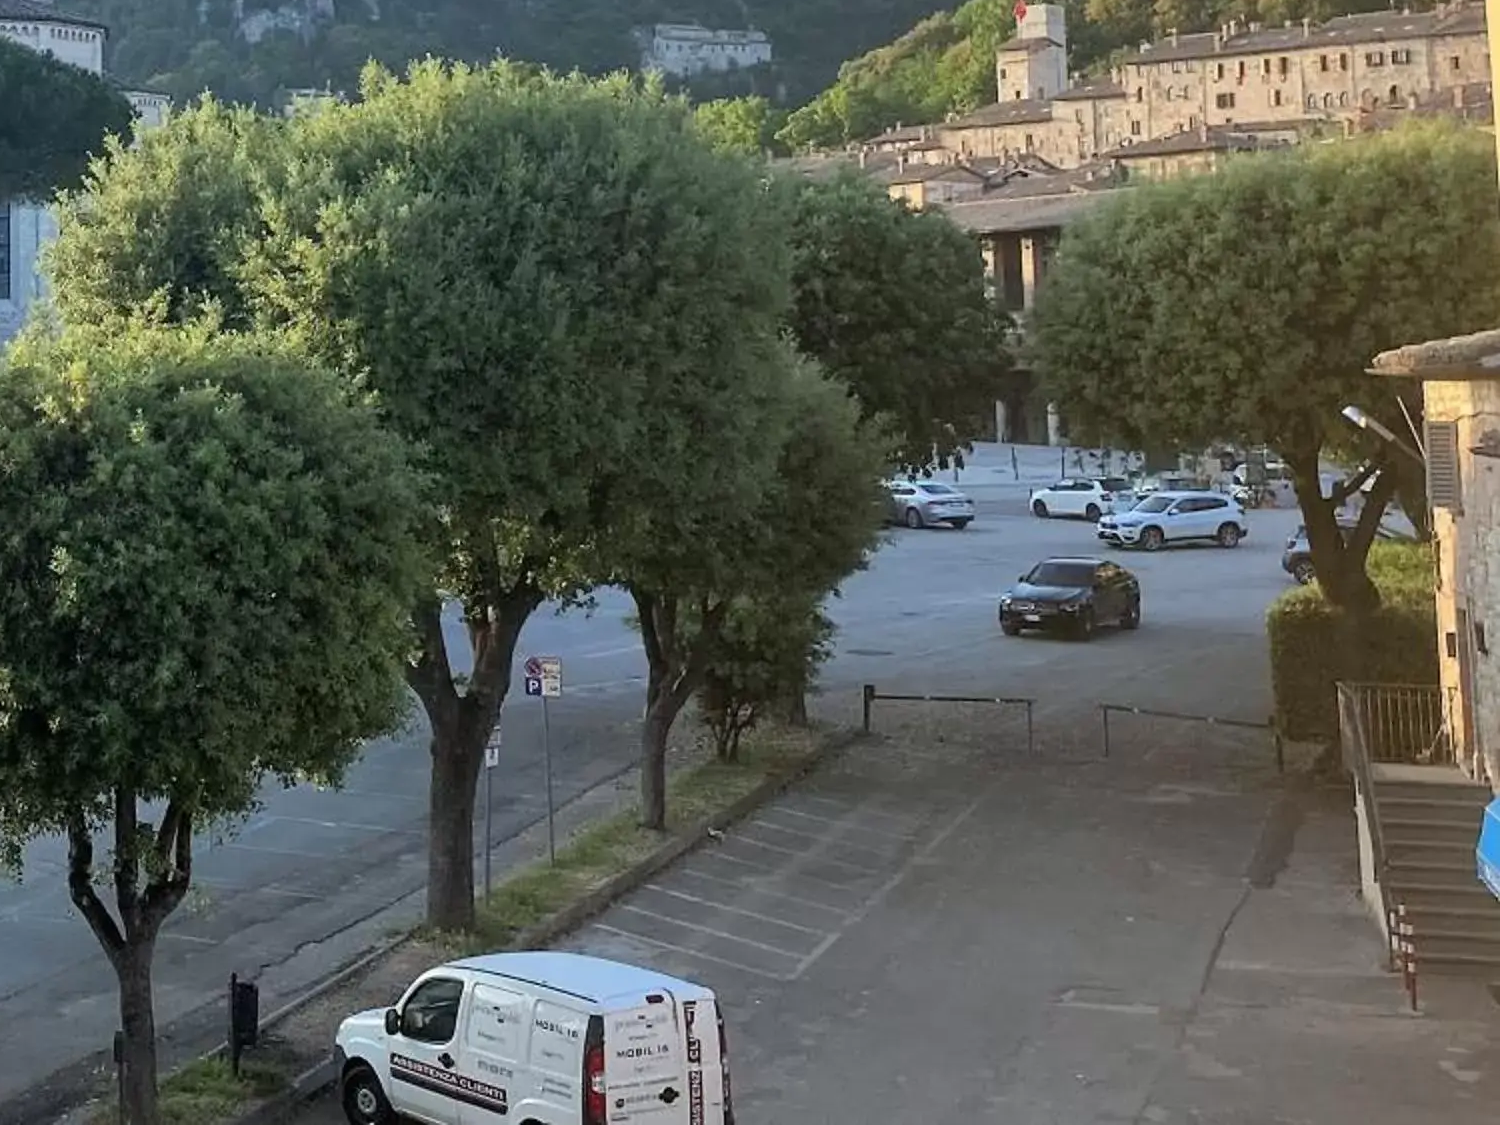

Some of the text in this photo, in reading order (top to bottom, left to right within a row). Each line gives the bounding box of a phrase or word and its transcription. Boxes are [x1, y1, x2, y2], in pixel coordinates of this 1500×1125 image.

[529, 679, 538, 693] P
[393, 1055, 458, 1084] ASSISTENZA
[459, 1078, 504, 1100] CLIENTI
